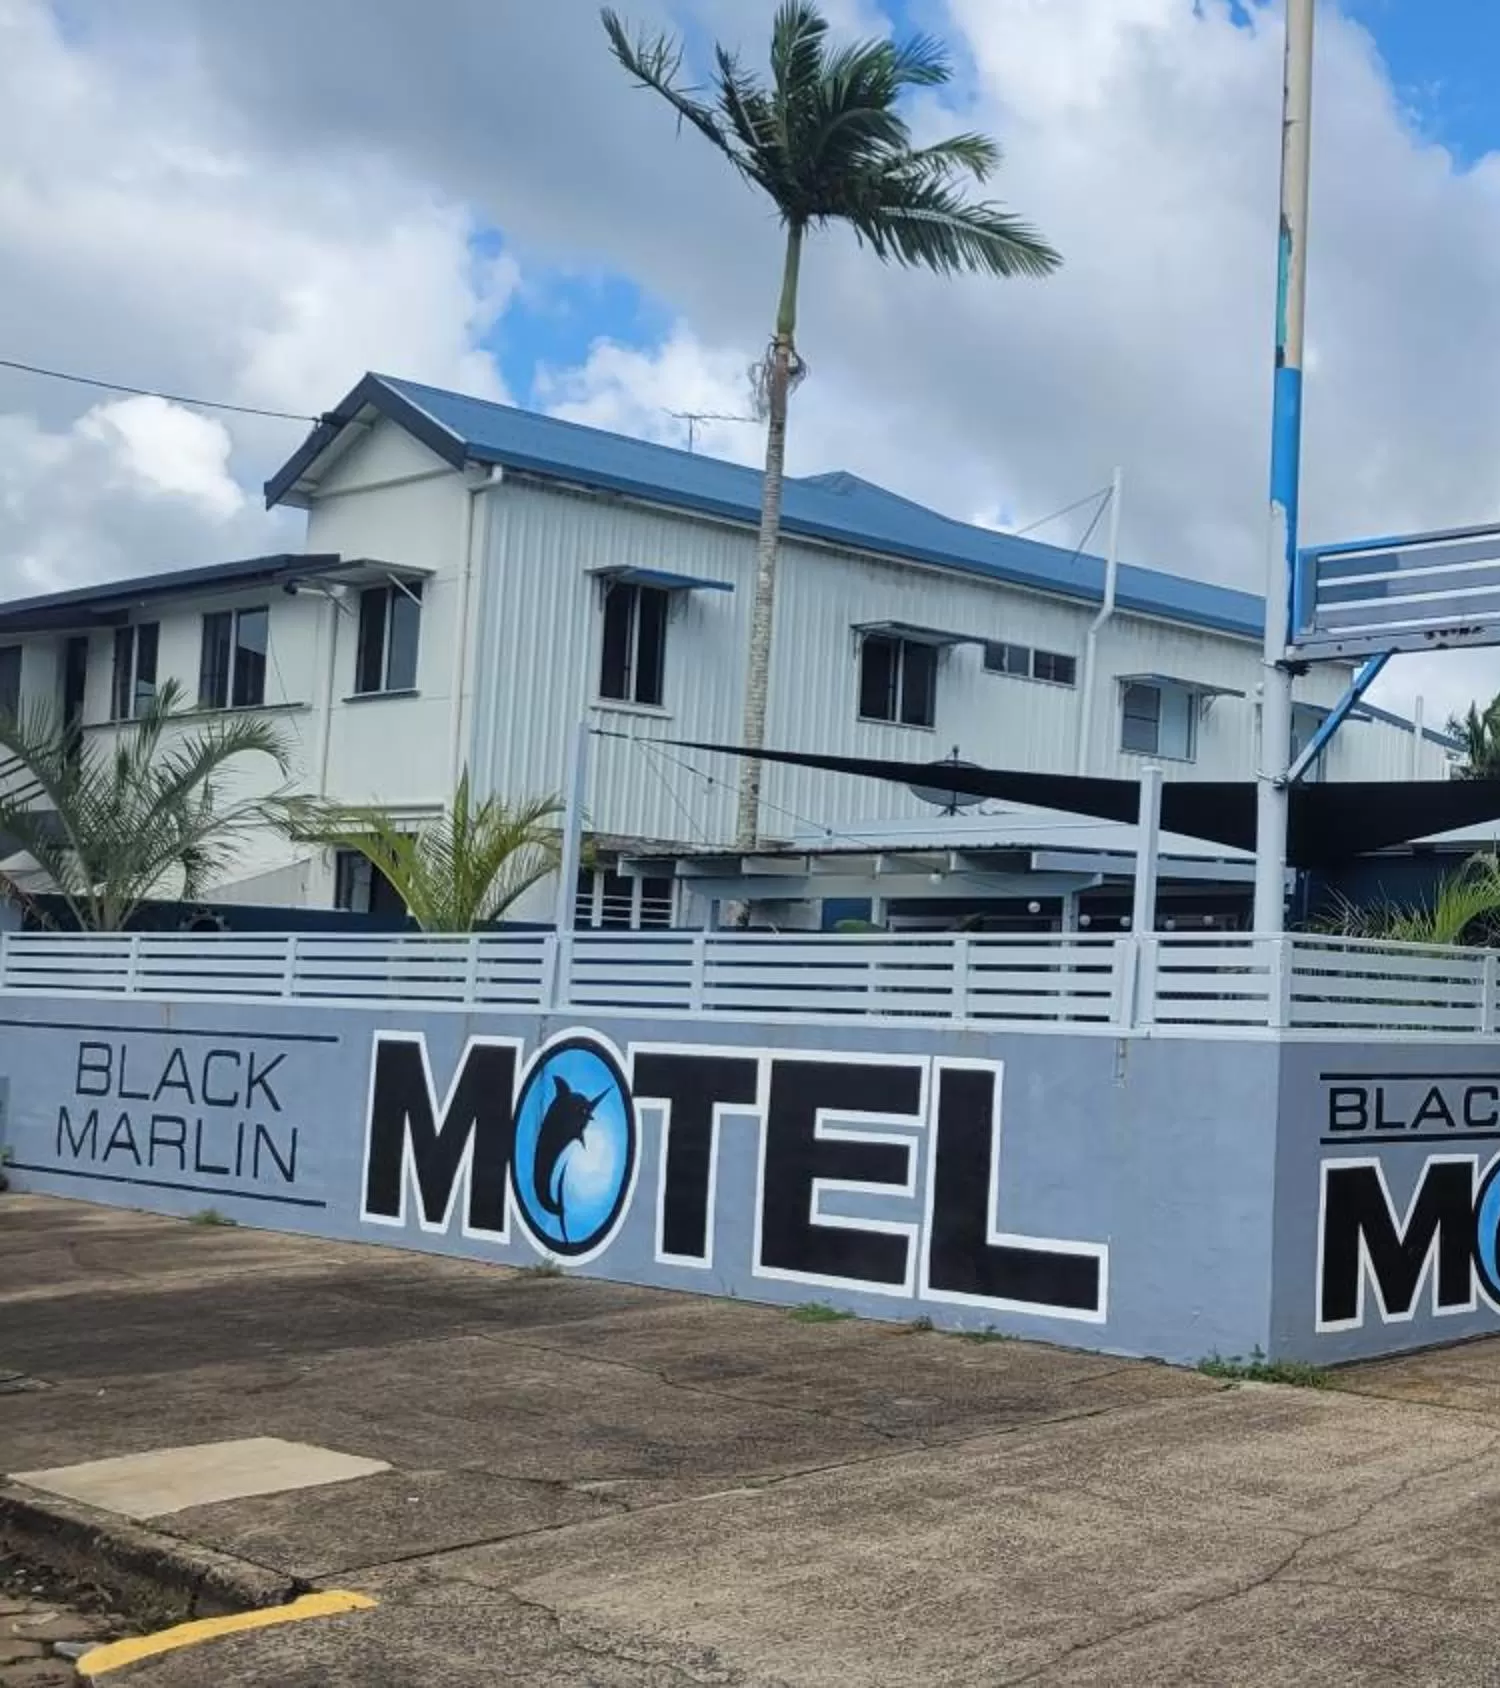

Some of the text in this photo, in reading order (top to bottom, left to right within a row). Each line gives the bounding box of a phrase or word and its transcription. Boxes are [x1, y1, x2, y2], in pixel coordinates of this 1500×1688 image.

[74, 1040, 289, 1112] BLACK
[55, 1105, 299, 1184] MARLIN
[360, 1026, 1109, 1323] MOTEL
